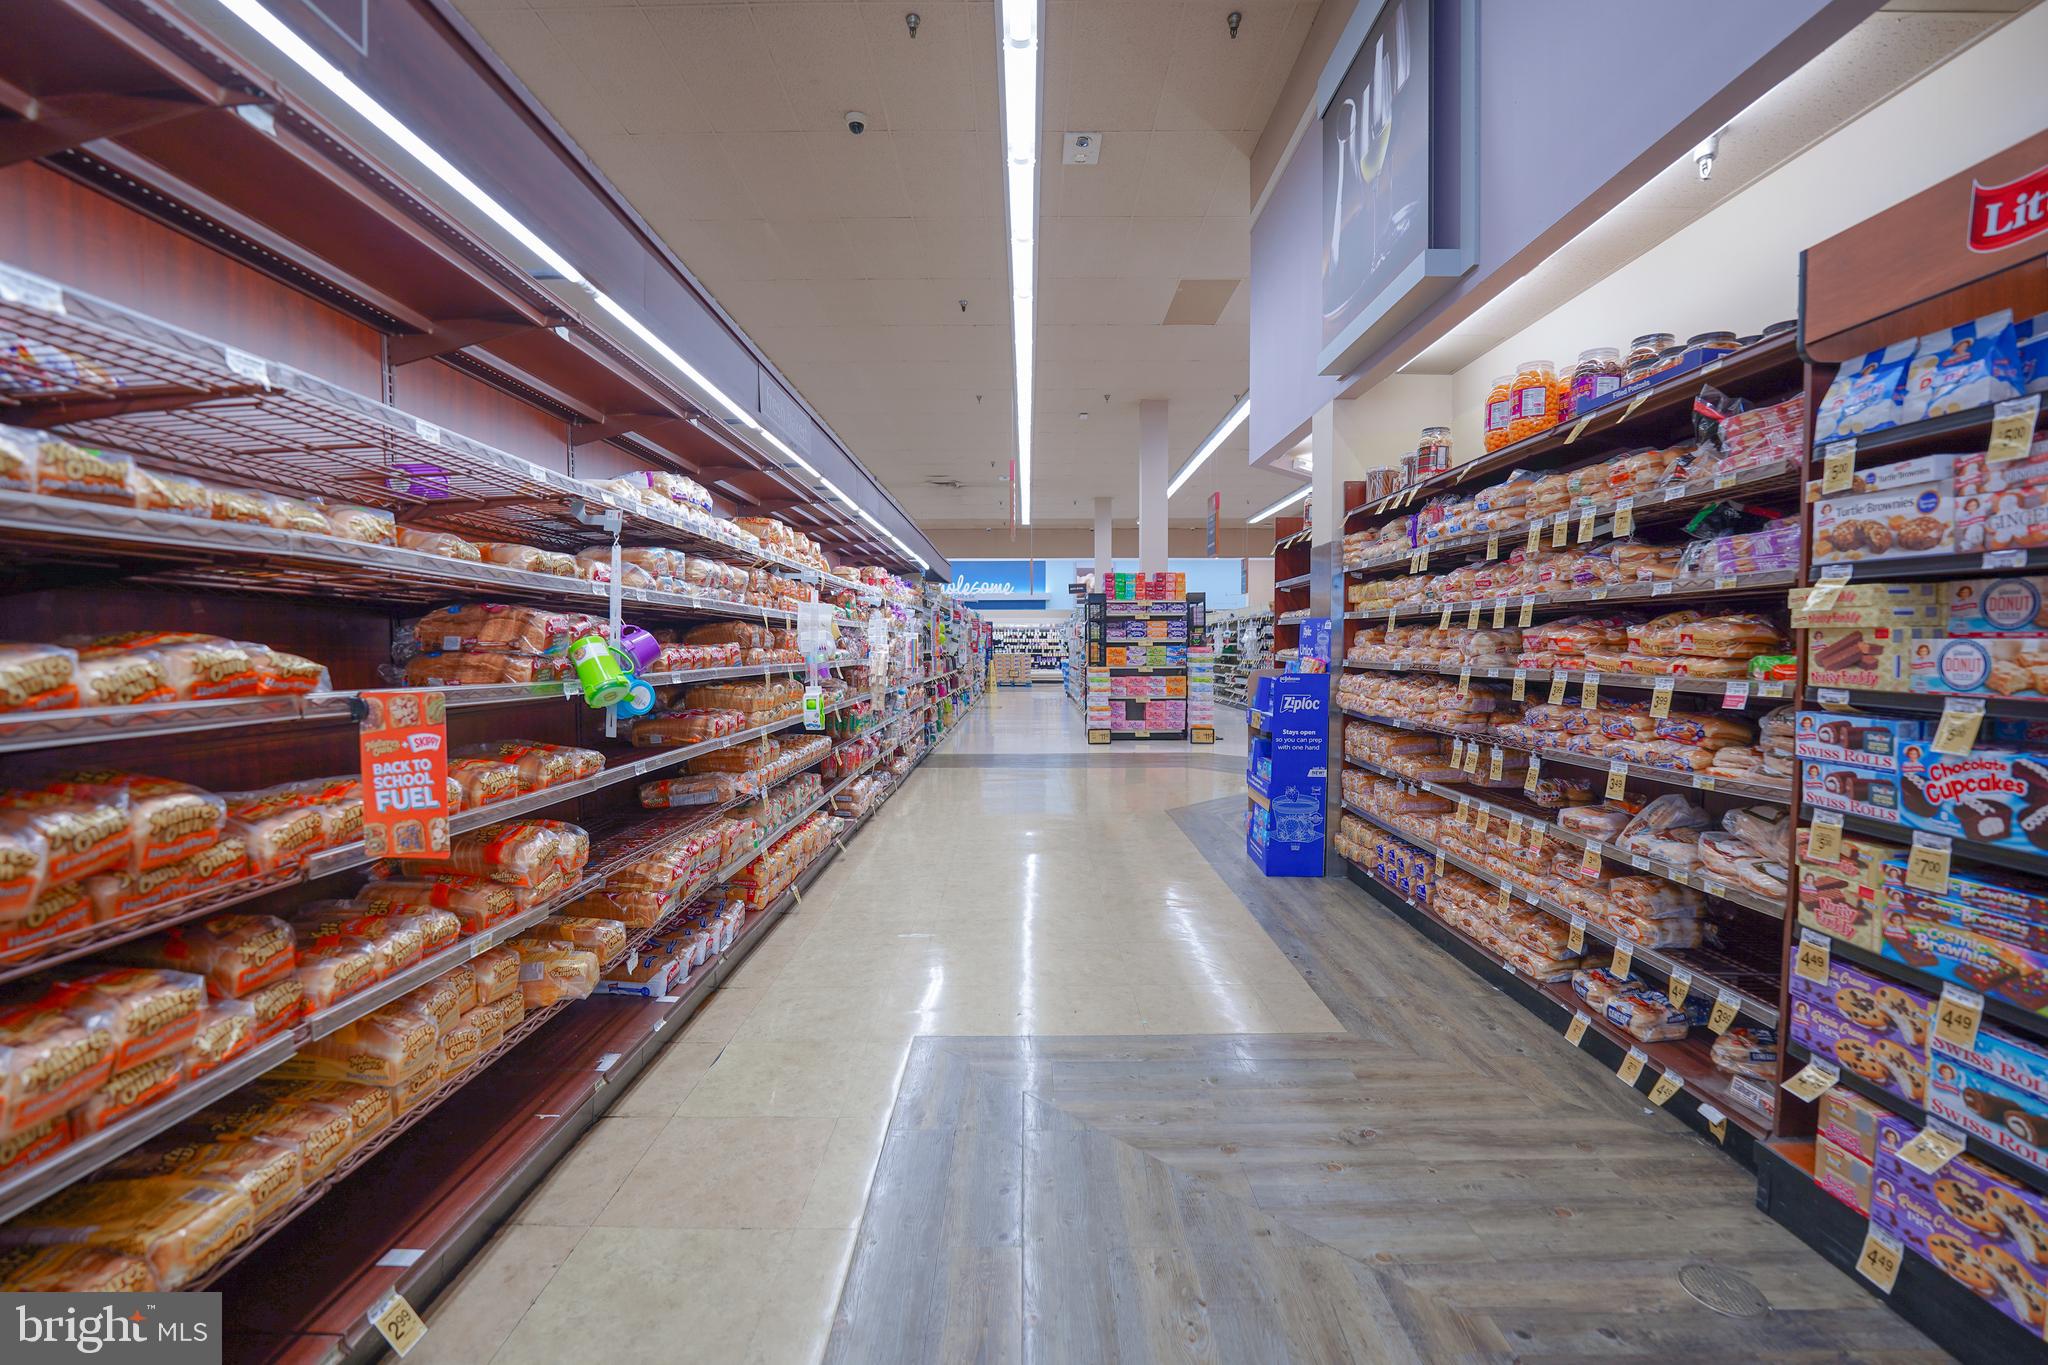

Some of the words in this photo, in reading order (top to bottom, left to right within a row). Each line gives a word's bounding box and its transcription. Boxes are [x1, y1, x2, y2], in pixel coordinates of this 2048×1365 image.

[1982, 190, 2048, 238] Lit
[1612, 387, 1628, 398] Filled
[1628, 380, 1650, 394] Pretzels
[1836, 506, 1864, 517] Turtle
[1865, 497, 1914, 513] Brownies
[1989, 595, 2029, 612] DONUT
[1945, 657, 1981, 672] DONUT
[1811, 670, 1841, 683] Nutty
[1283, 696, 1320, 713] Ziploc
[414, 735, 438, 748] SKIPPY
[372, 760, 412, 776] BACK
[411, 758, 433, 771] TO
[1930, 758, 2007, 781] Chocolate
[374, 772, 435, 790] SCHOOL
[1926, 773, 2025, 803] Cupcakes
[375, 786, 441, 814] FUEL
[1915, 932, 2000, 967] Brownies
[1927, 928, 1990, 952] Cosmic
[2000, 1062, 2048, 1094] ROL
[1897, 1193, 1933, 1220] Raisin
[1933, 1214, 1973, 1245] Creme
